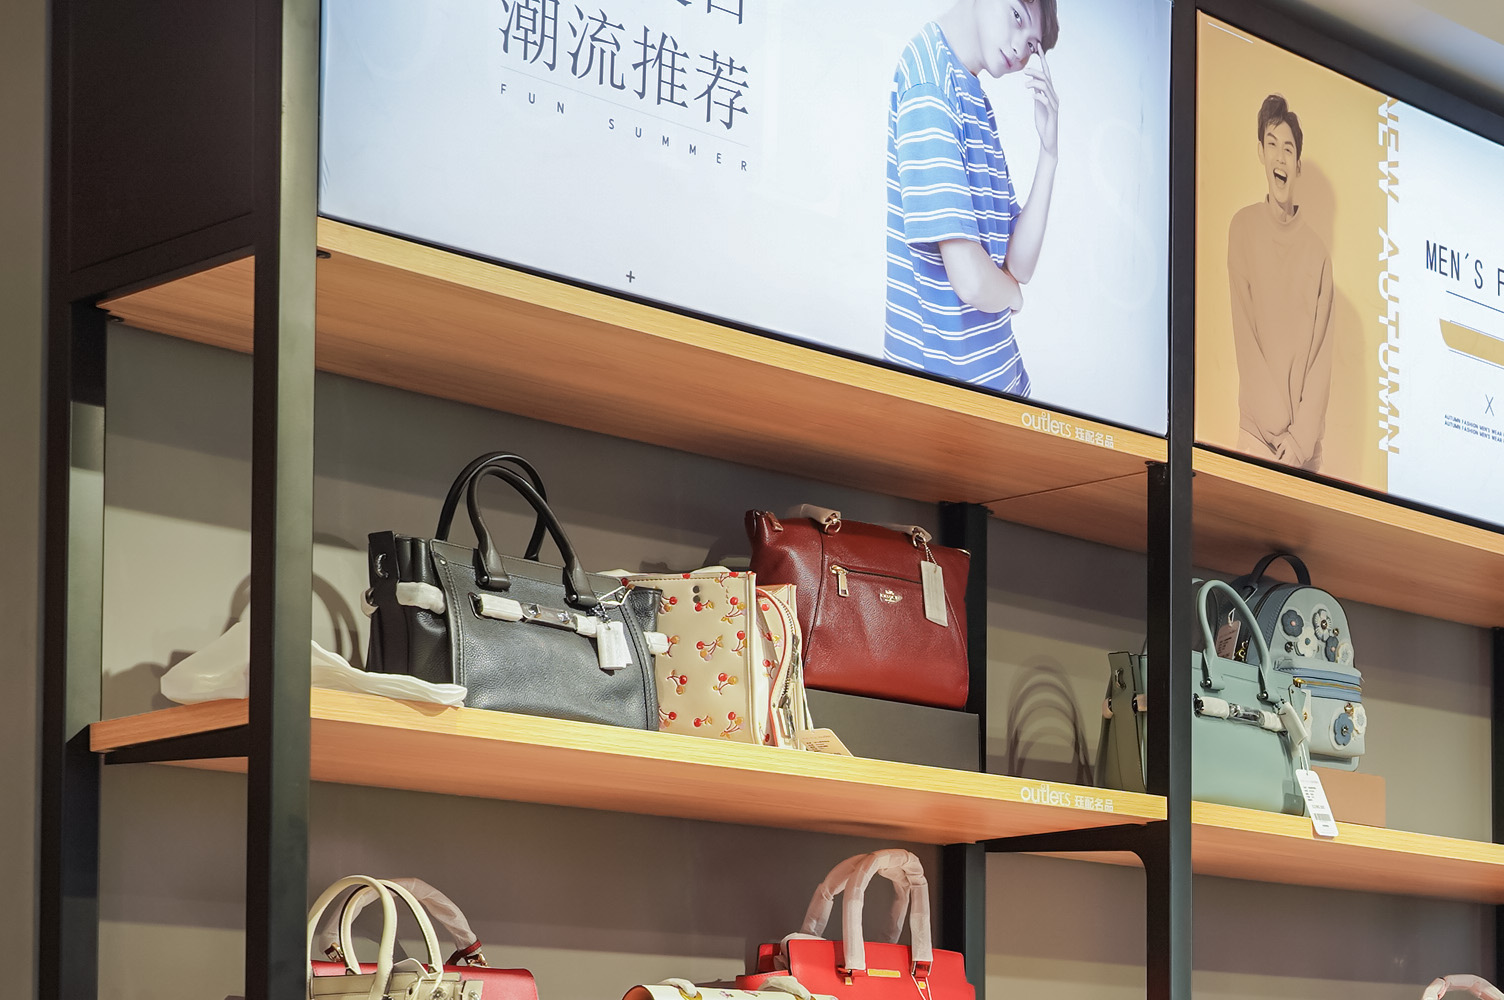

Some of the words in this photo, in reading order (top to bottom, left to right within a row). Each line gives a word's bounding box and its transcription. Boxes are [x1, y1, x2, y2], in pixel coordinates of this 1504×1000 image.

[498, 0, 750, 130] 潮流推荐
[500, 83, 565, 115] FUN
[608, 118, 748, 172] SUMMER
[1426, 239, 1483, 290] MEN'S
[1377, 226, 1400, 455] AUTUMN
[1021, 411, 1072, 438] outlets
[1020, 783, 1071, 808] outlets
